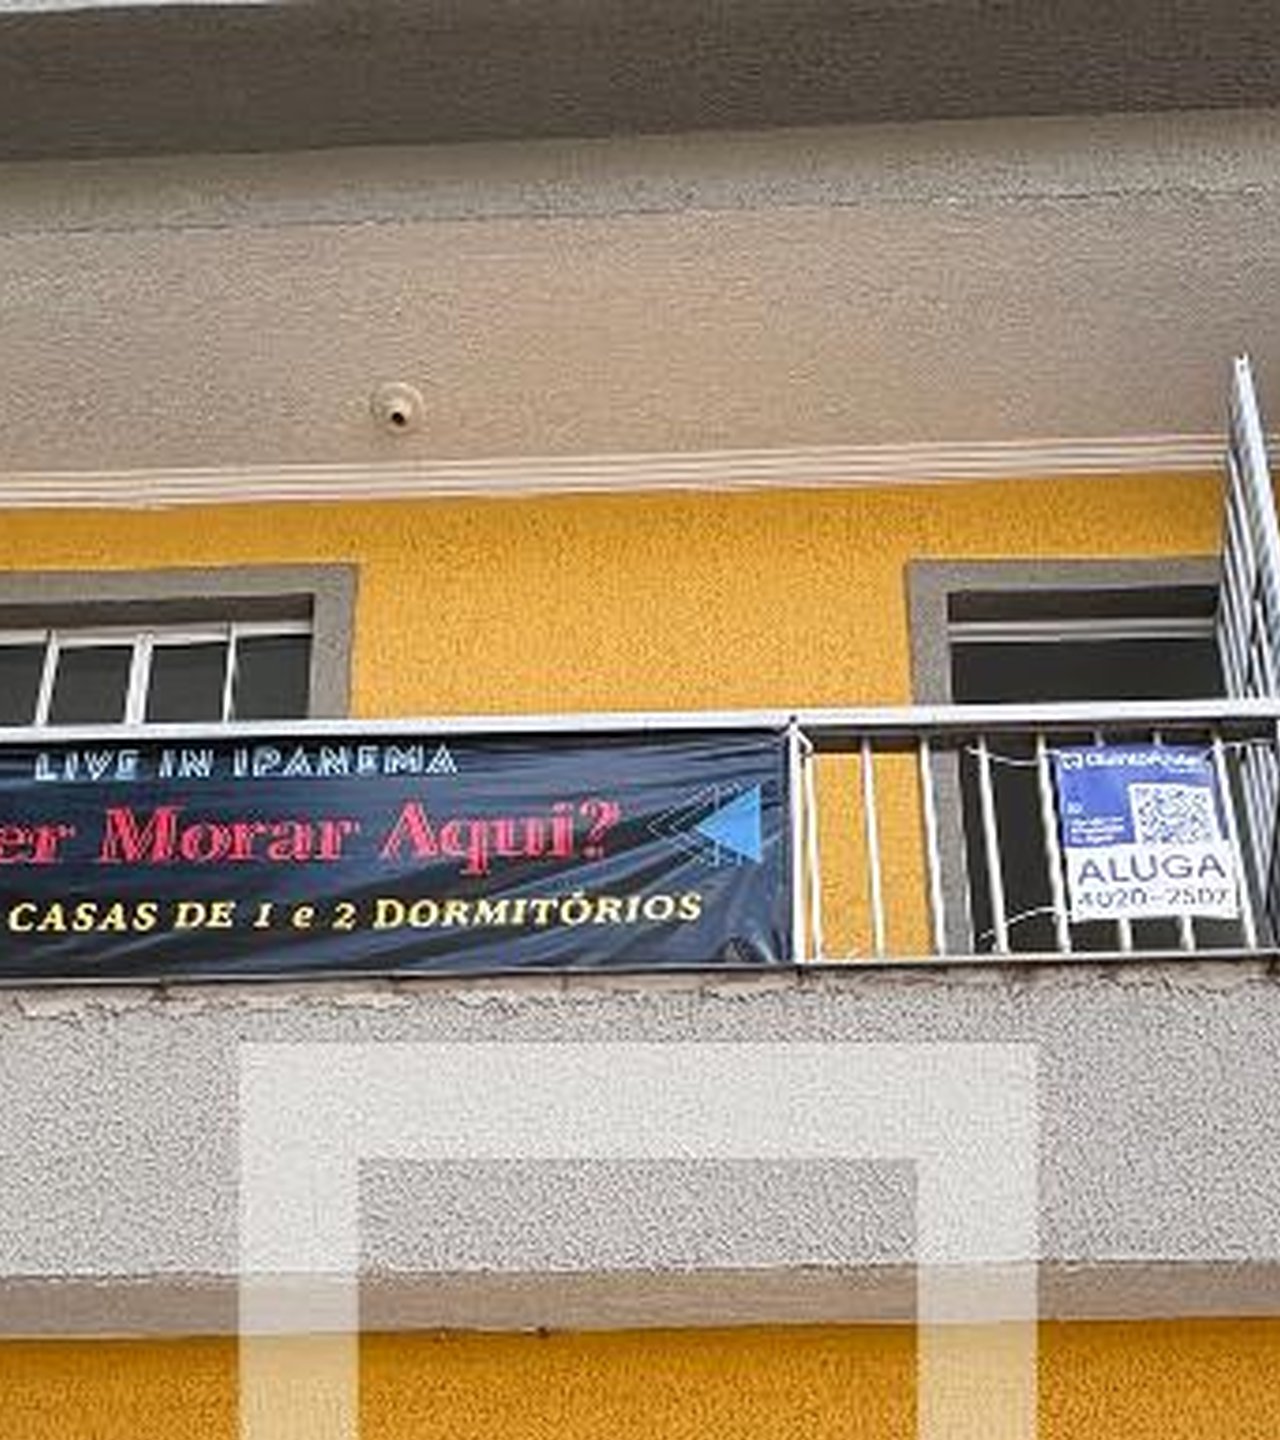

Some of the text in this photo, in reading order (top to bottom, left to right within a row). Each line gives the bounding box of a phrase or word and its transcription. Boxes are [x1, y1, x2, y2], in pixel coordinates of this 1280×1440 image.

[34, 744, 459, 781] LIVE IN IPANEMA
[99, 800, 360, 865] Morar
[382, 797, 622, 876] Aqui?
[1077, 854, 1227, 886] ALUGA
[7, 901, 159, 933] CASAS
[174, 900, 234, 930] DE
[291, 907, 316, 930] e
[331, 902, 358, 930] 2
[372, 889, 704, 930] DORMITÓRIOS
